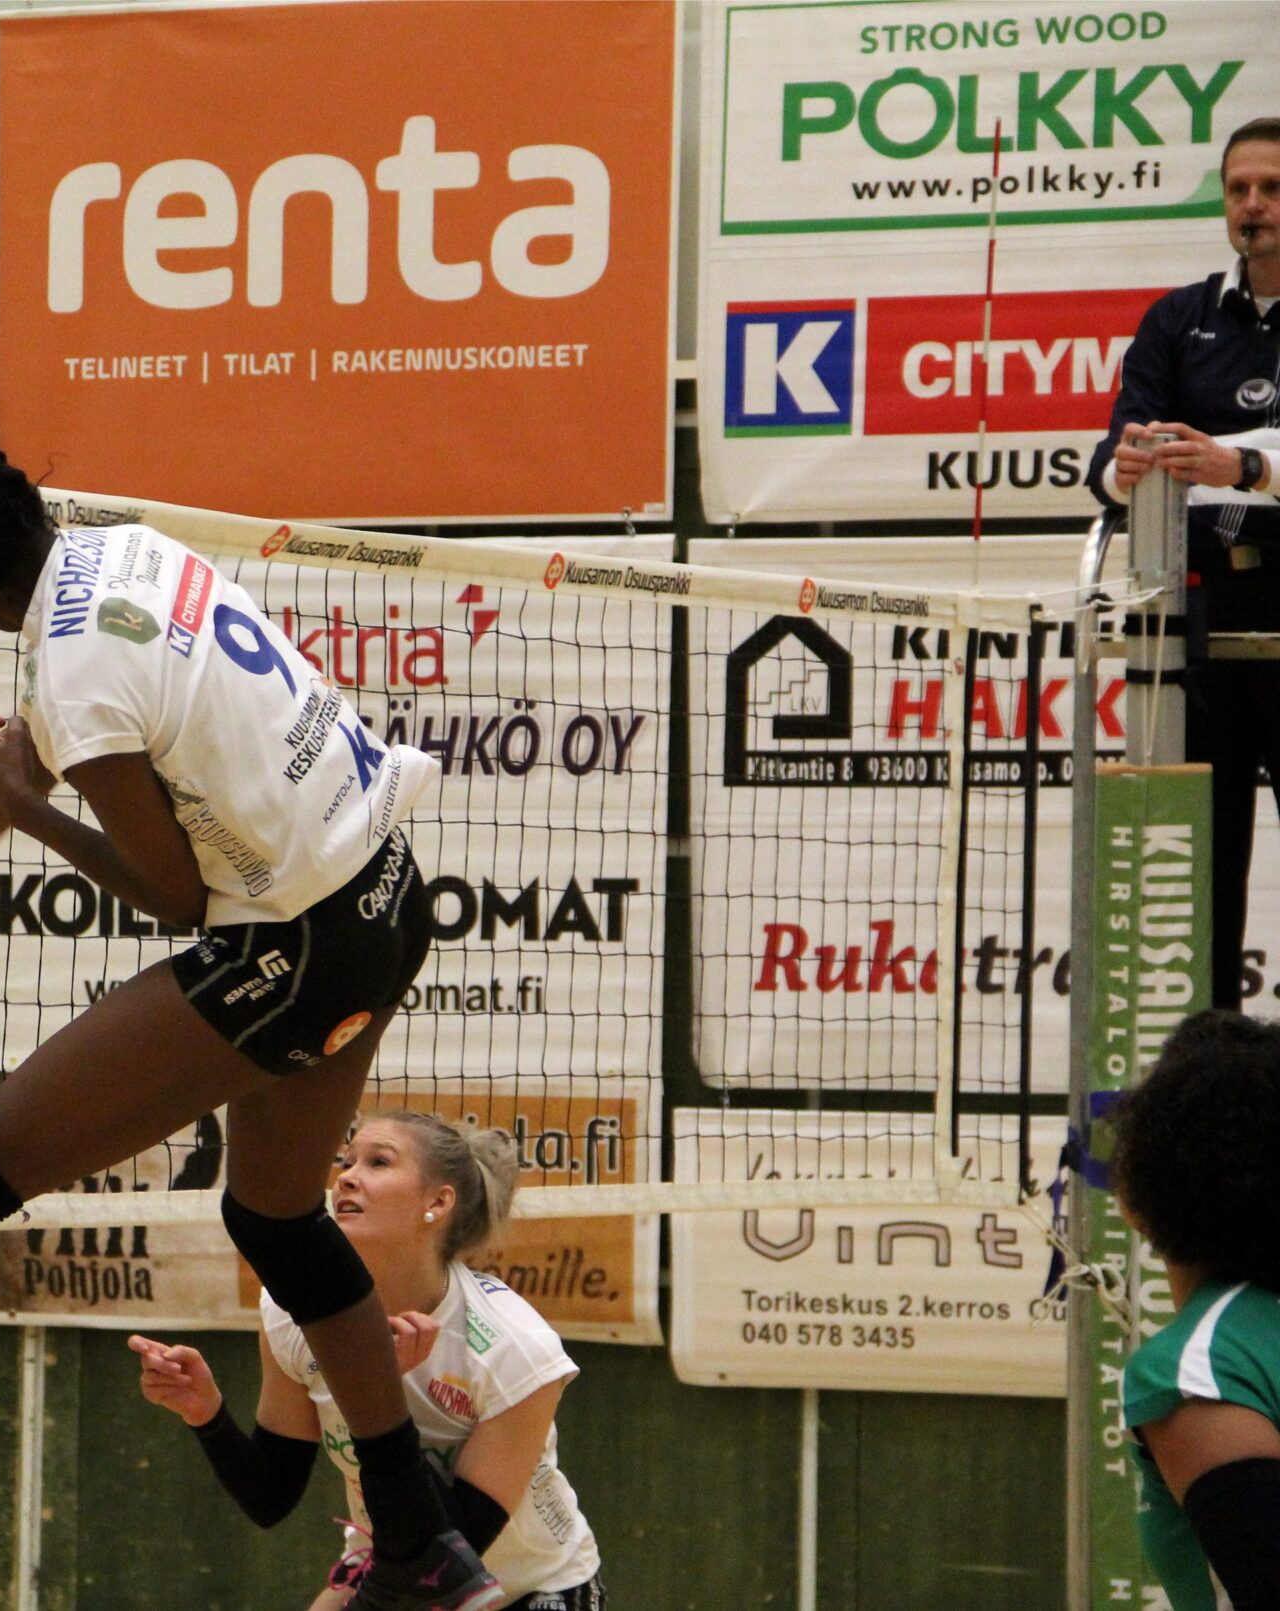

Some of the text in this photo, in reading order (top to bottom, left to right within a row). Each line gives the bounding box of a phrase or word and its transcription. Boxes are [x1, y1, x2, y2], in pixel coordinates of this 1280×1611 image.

[860, 11, 1167, 54] STRONG WOOD
[852, 162, 1161, 202] www.polkky.fi
[47, 115, 611, 313] renta
[65, 344, 589, 380] TELINEET TILAT RAKENNUSKONEET
[742, 321, 1132, 416] K CITYM
[926, 447, 1098, 490] KUUS
[282, 536, 425, 569] Kuusamon Osuuspankki
[564, 564, 691, 597] Kuusamon Osuuspankki
[213, 603, 299, 699] 9
[561, 714, 647, 777] OY
[747, 756, 835, 783] Kitkantie
[842, 757, 853, 781] 8
[868, 756, 928, 781] 93600
[322, 773, 356, 825] KANTOLA
[1106, 825, 1133, 1077] HIRSITALO
[23, 1258, 154, 1306] Pohjola
[742, 1290, 888, 1316] Torikeskus
[899, 1295, 1010, 1320] 2.kerros
[742, 1323, 916, 1349] 040 578 3435
